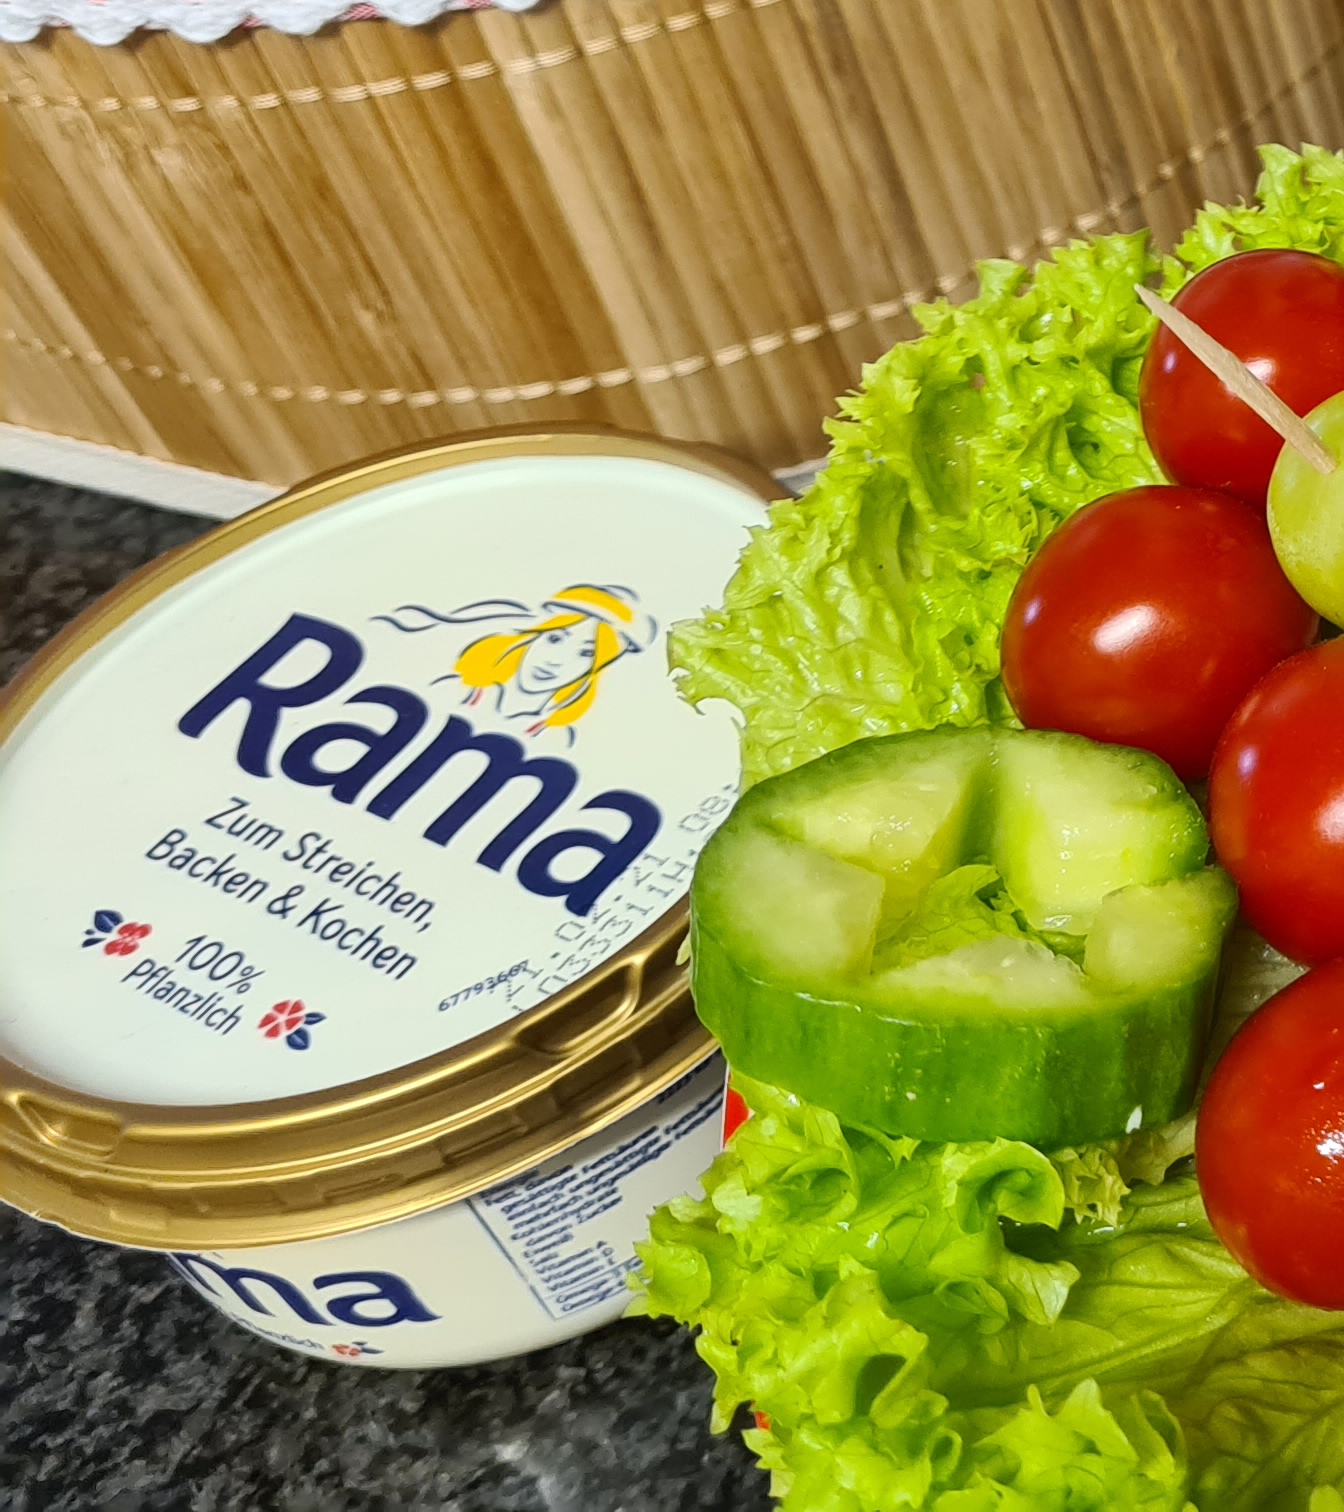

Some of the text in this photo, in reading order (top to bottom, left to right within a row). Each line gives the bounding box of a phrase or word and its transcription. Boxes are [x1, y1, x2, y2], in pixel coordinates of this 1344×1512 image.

[177, 612, 663, 918] Rama
[145, 828, 419, 981] Backen & Kochen
[204, 796, 436, 934] Zum Streichen,
[120, 957, 244, 1036] Pflanzlich
[174, 934, 267, 995] 100%
